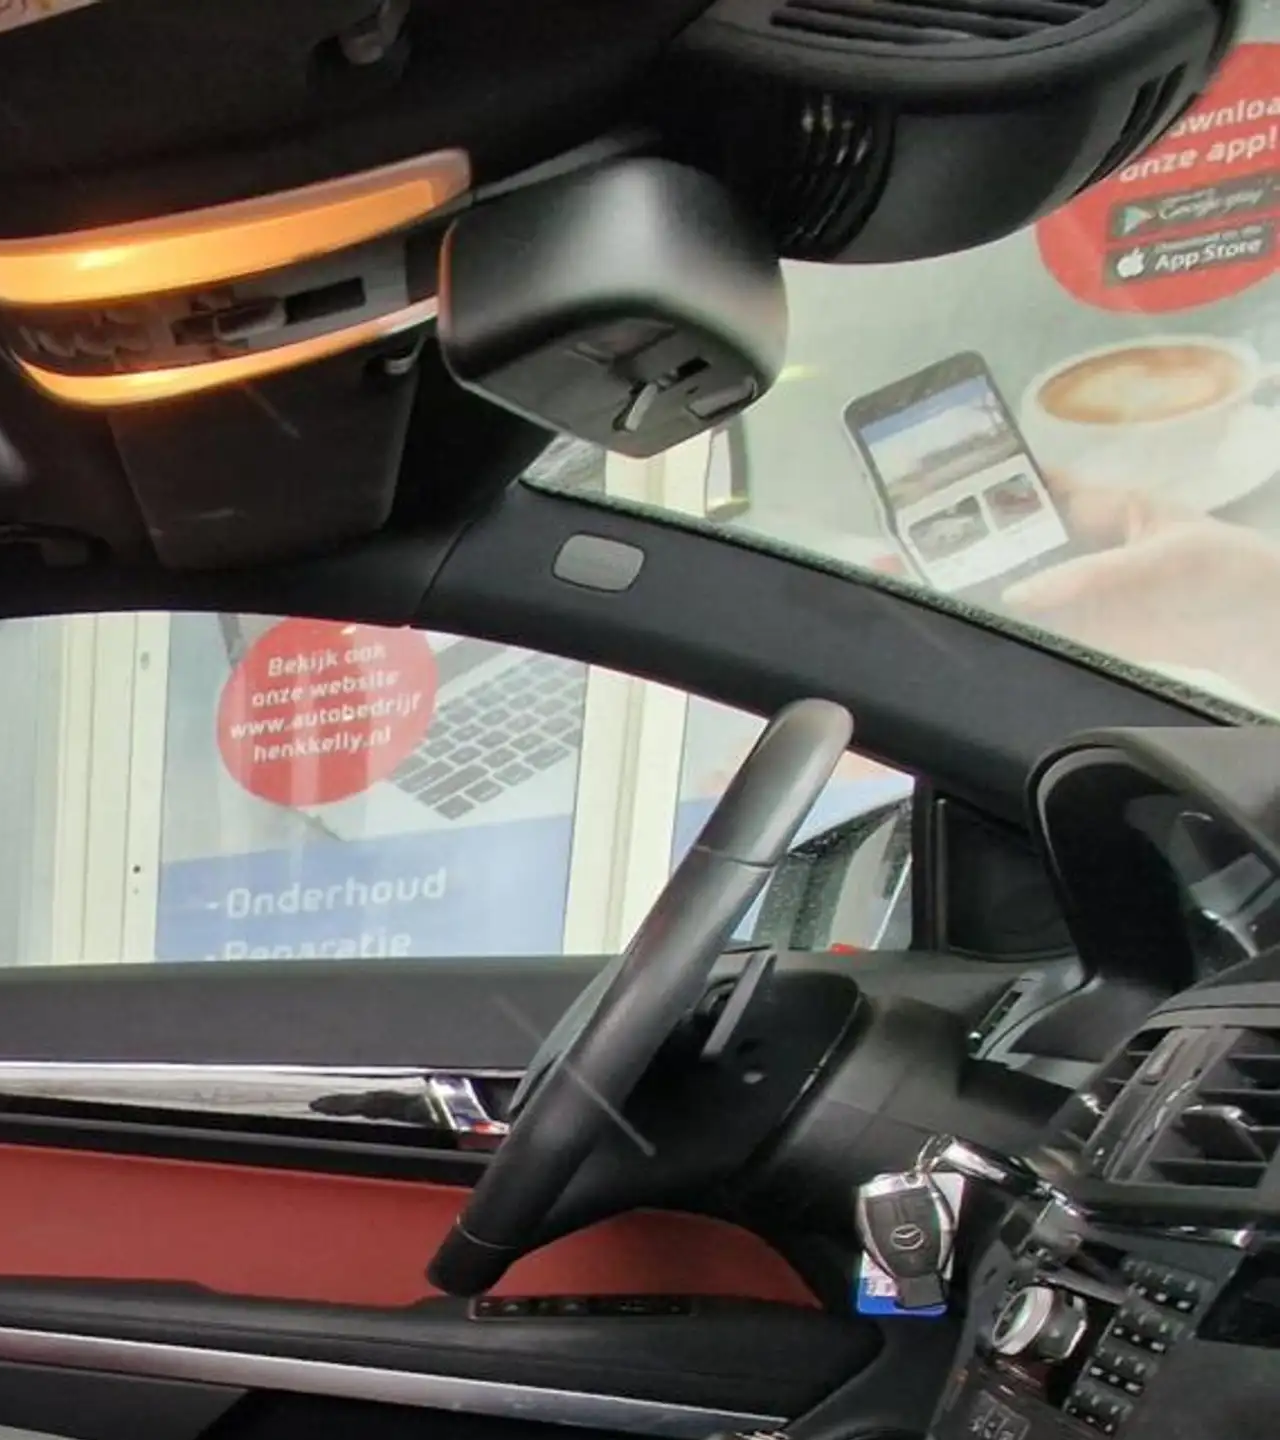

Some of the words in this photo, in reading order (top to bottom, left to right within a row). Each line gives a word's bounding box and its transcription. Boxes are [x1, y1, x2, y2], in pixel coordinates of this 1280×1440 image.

[1120, 148, 1198, 182] onze
[1206, 124, 1279, 164] app!
[1154, 253, 1199, 272] App
[1202, 239, 1263, 261] Store
[268, 653, 338, 678] Bekijk
[344, 643, 387, 664] ook
[252, 686, 304, 709] onze
[309, 669, 400, 698] website
